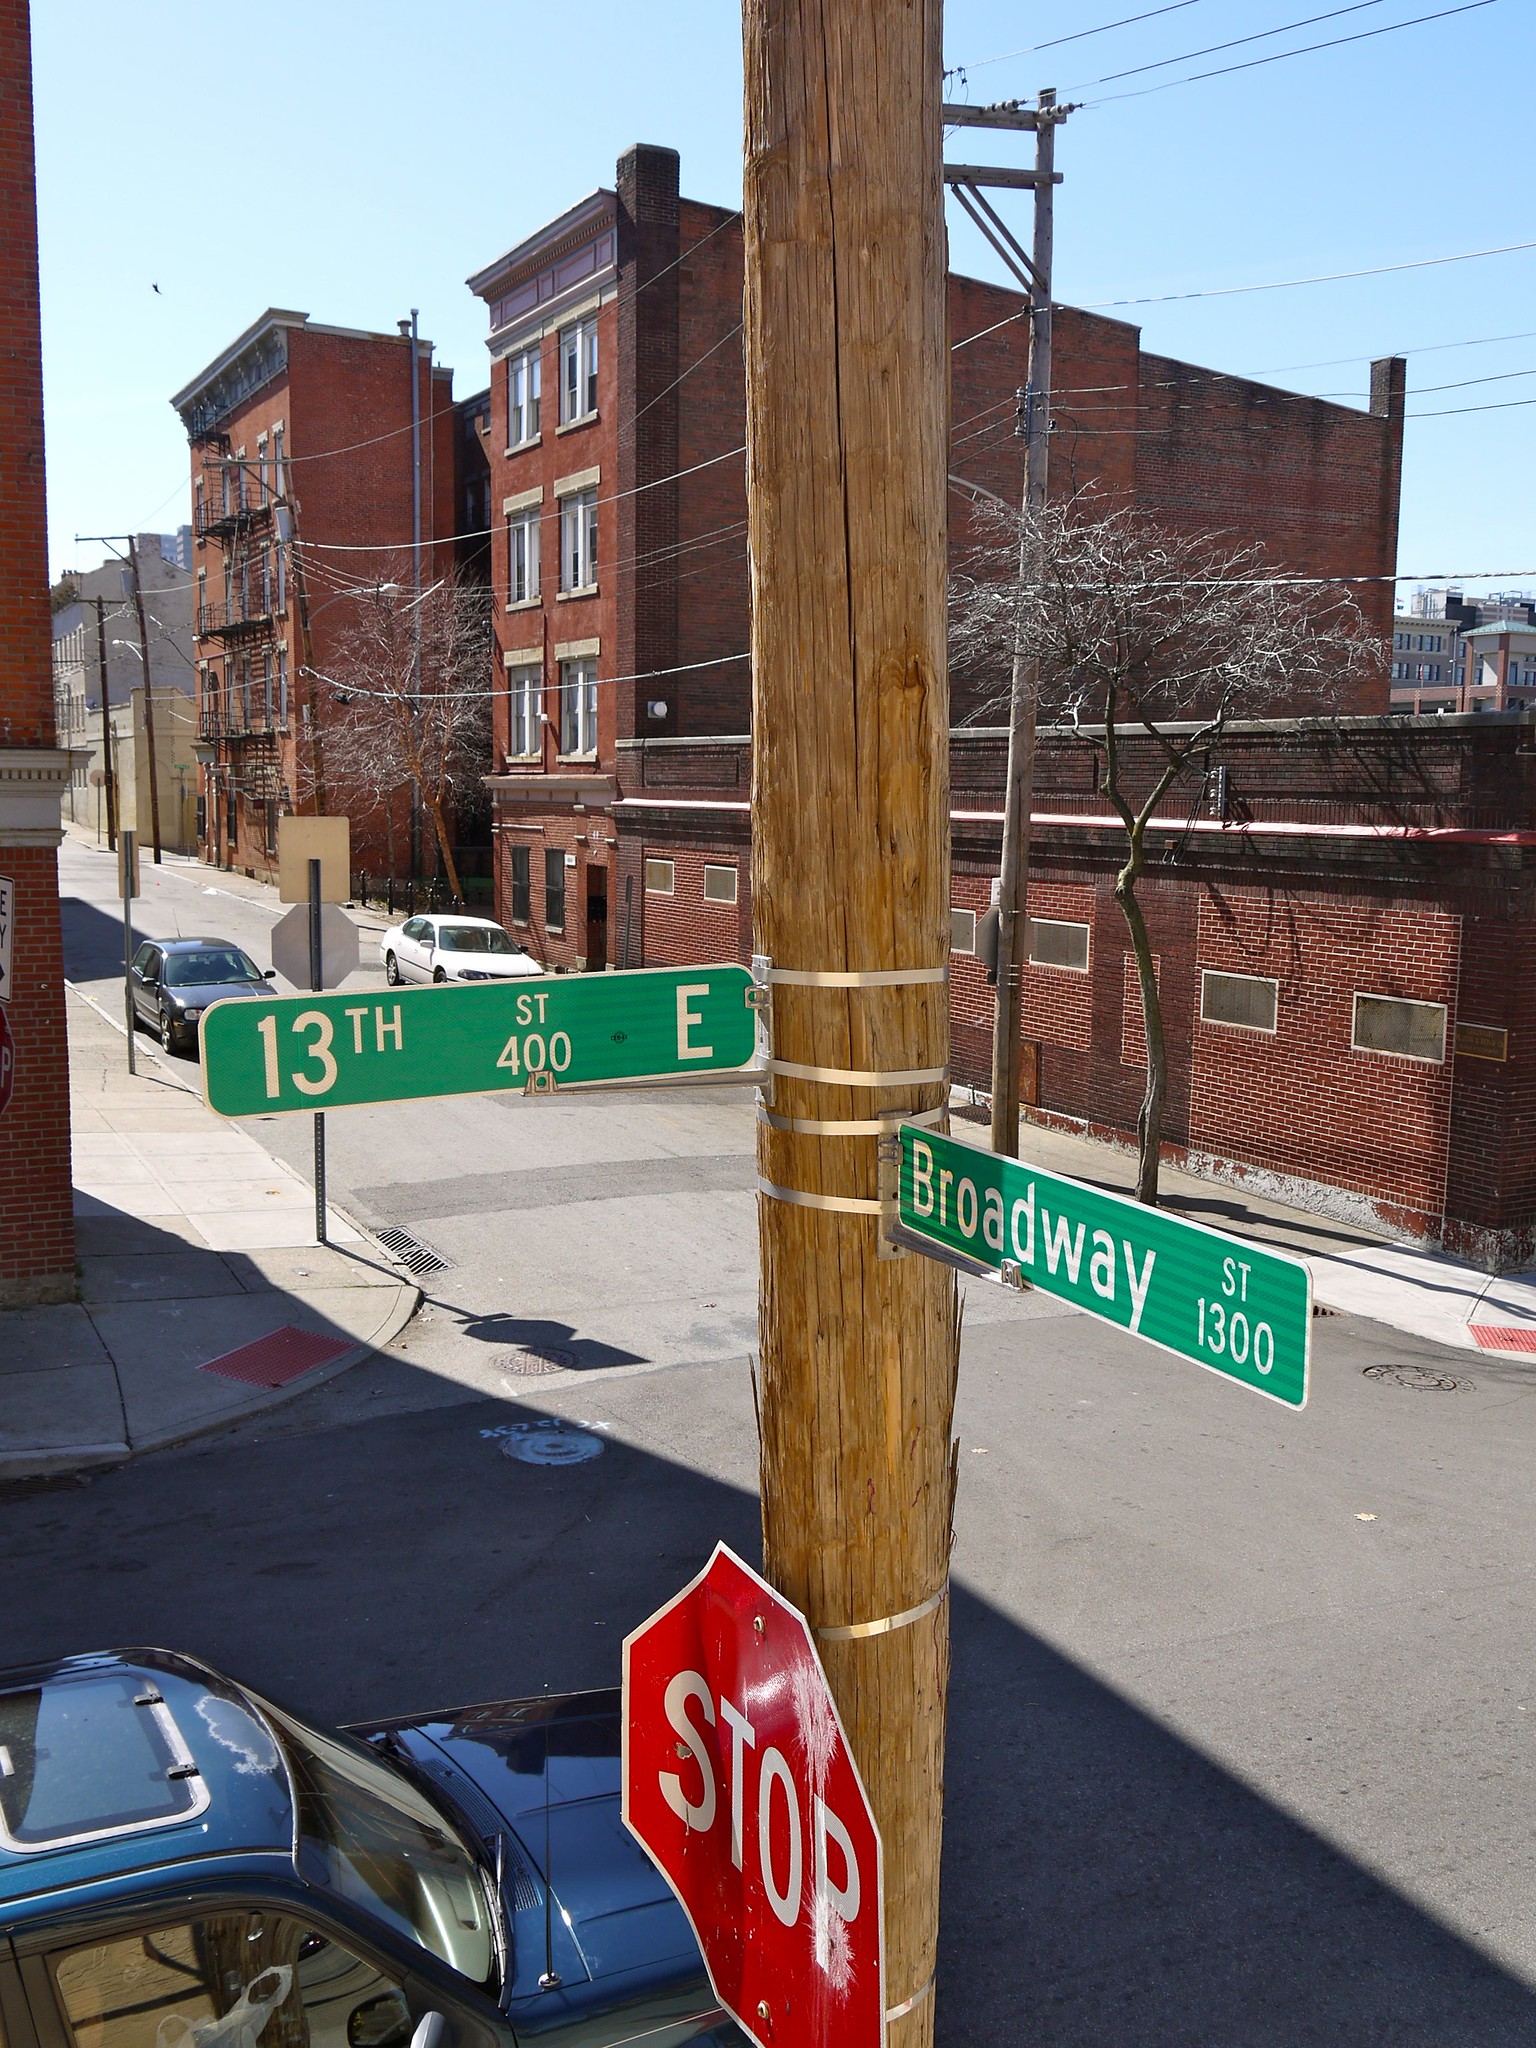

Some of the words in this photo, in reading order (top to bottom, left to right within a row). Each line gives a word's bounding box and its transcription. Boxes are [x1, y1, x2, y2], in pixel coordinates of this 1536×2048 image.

[257, 1005, 403, 1099] 13TH
[516, 993, 550, 1026] ST
[675, 983, 714, 1060] E
[496, 1032, 572, 1076] 400
[912, 1139, 1157, 1334] Broadway
[1221, 1257, 1252, 1302] ST
[1197, 1297, 1275, 1376] 1300
[658, 1669, 861, 1975] STOP
